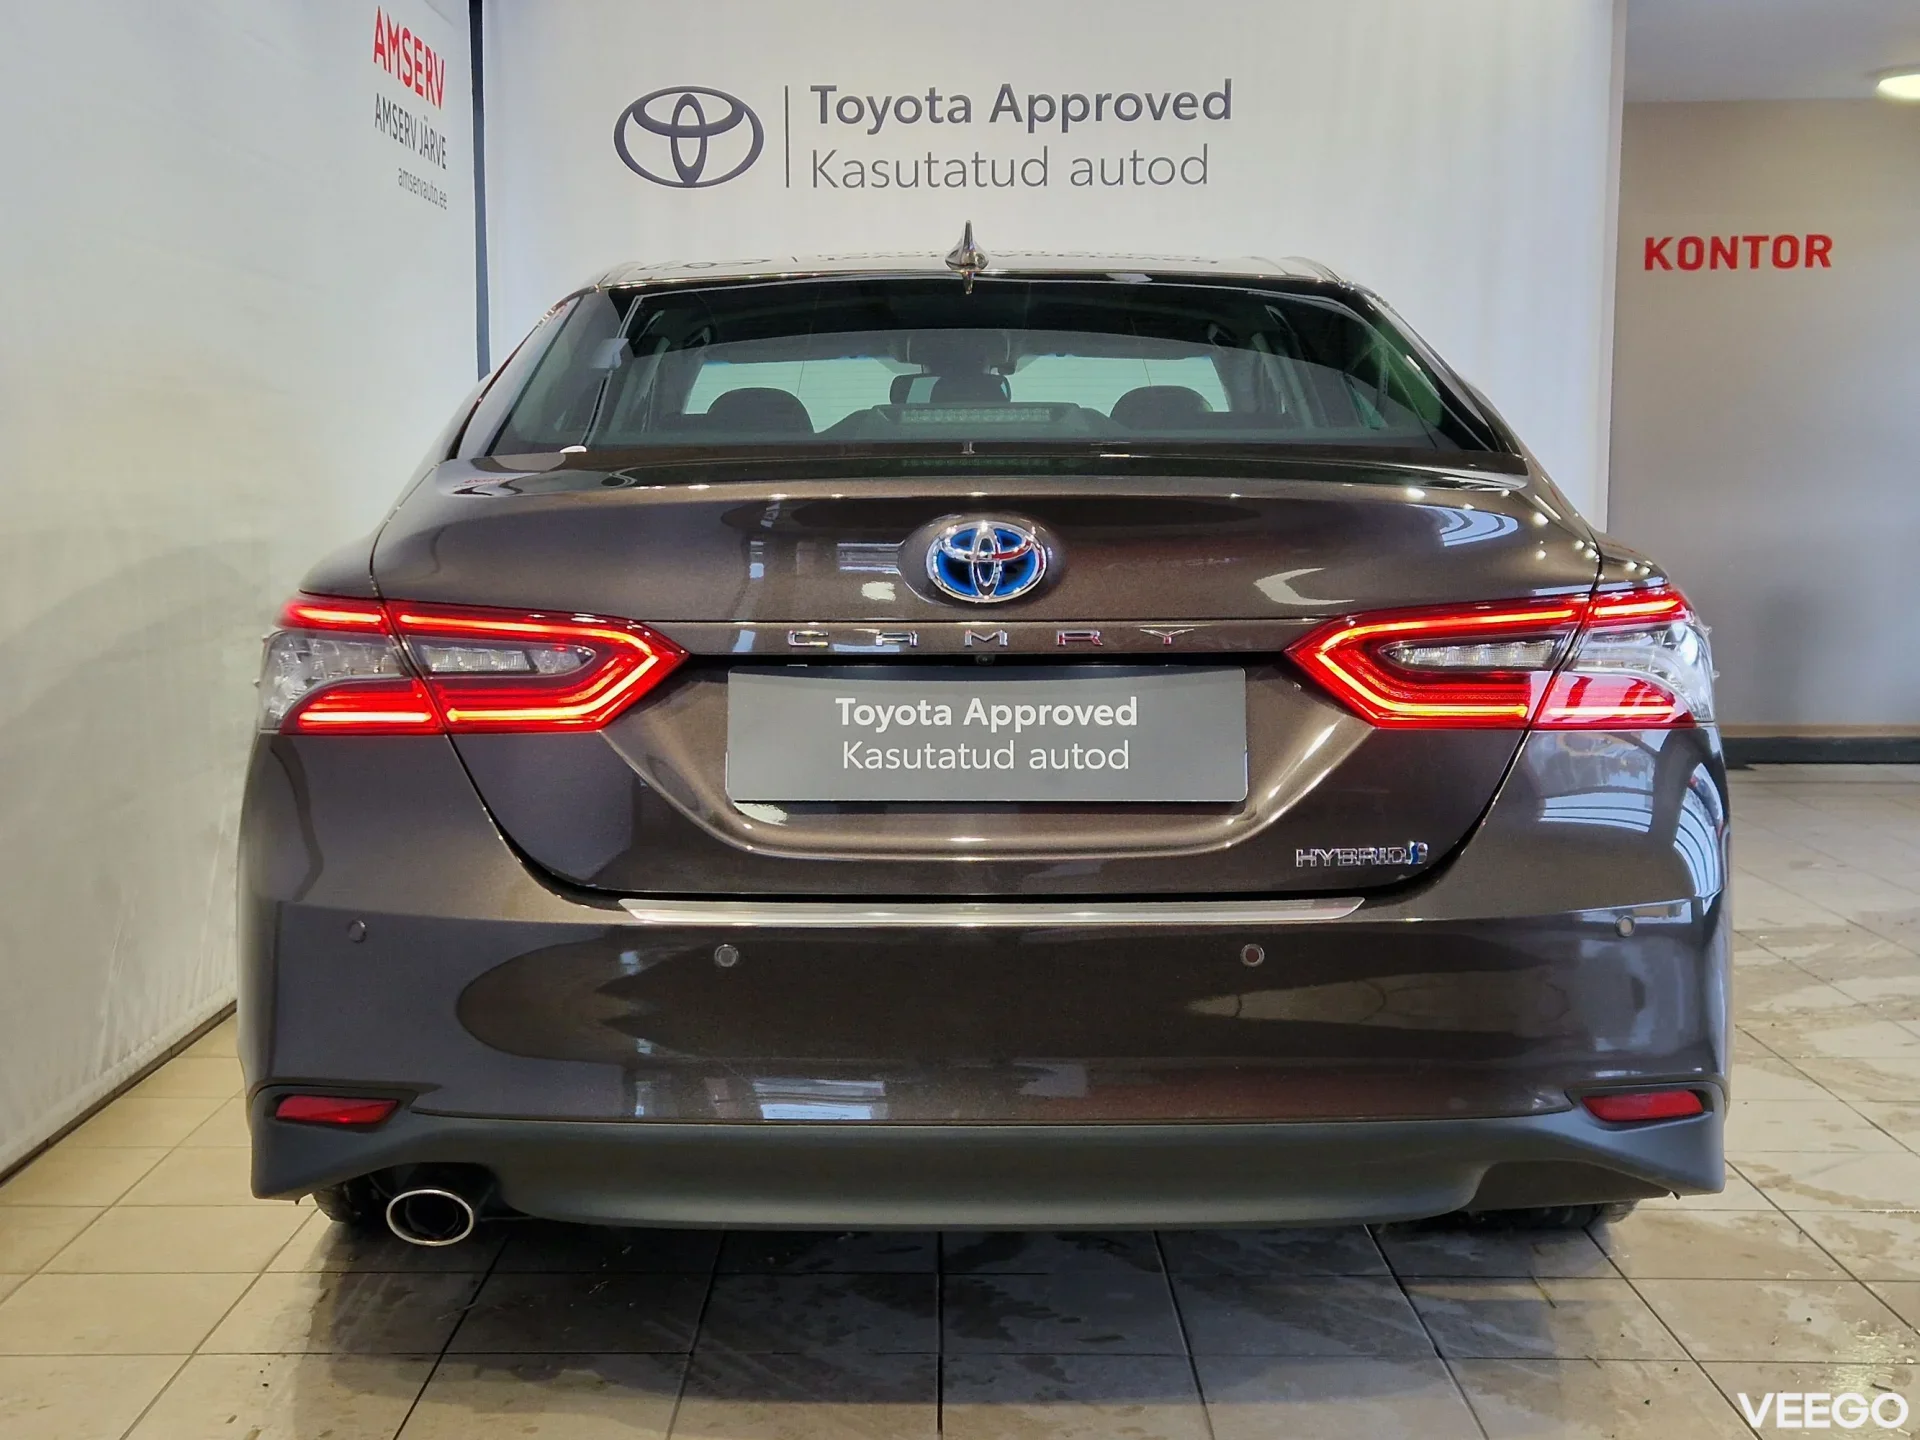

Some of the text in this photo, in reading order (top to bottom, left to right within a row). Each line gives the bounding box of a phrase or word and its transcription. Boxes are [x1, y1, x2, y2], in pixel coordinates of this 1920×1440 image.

[373, 5, 445, 110] AMSERV
[810, 78, 1232, 135] Toyota Approved
[374, 92, 447, 170] AMSERV JÄRVE
[811, 143, 1208, 188] Kasutatud autod
[397, 167, 448, 210] amservauto.ee
[1644, 234, 1833, 271] KONTOR
[787, 627, 1195, 647] CAMRY
[835, 697, 1138, 732] Toyota Approved
[842, 740, 1130, 770] Kasutatud autod
[1296, 847, 1407, 868] HYBRID
